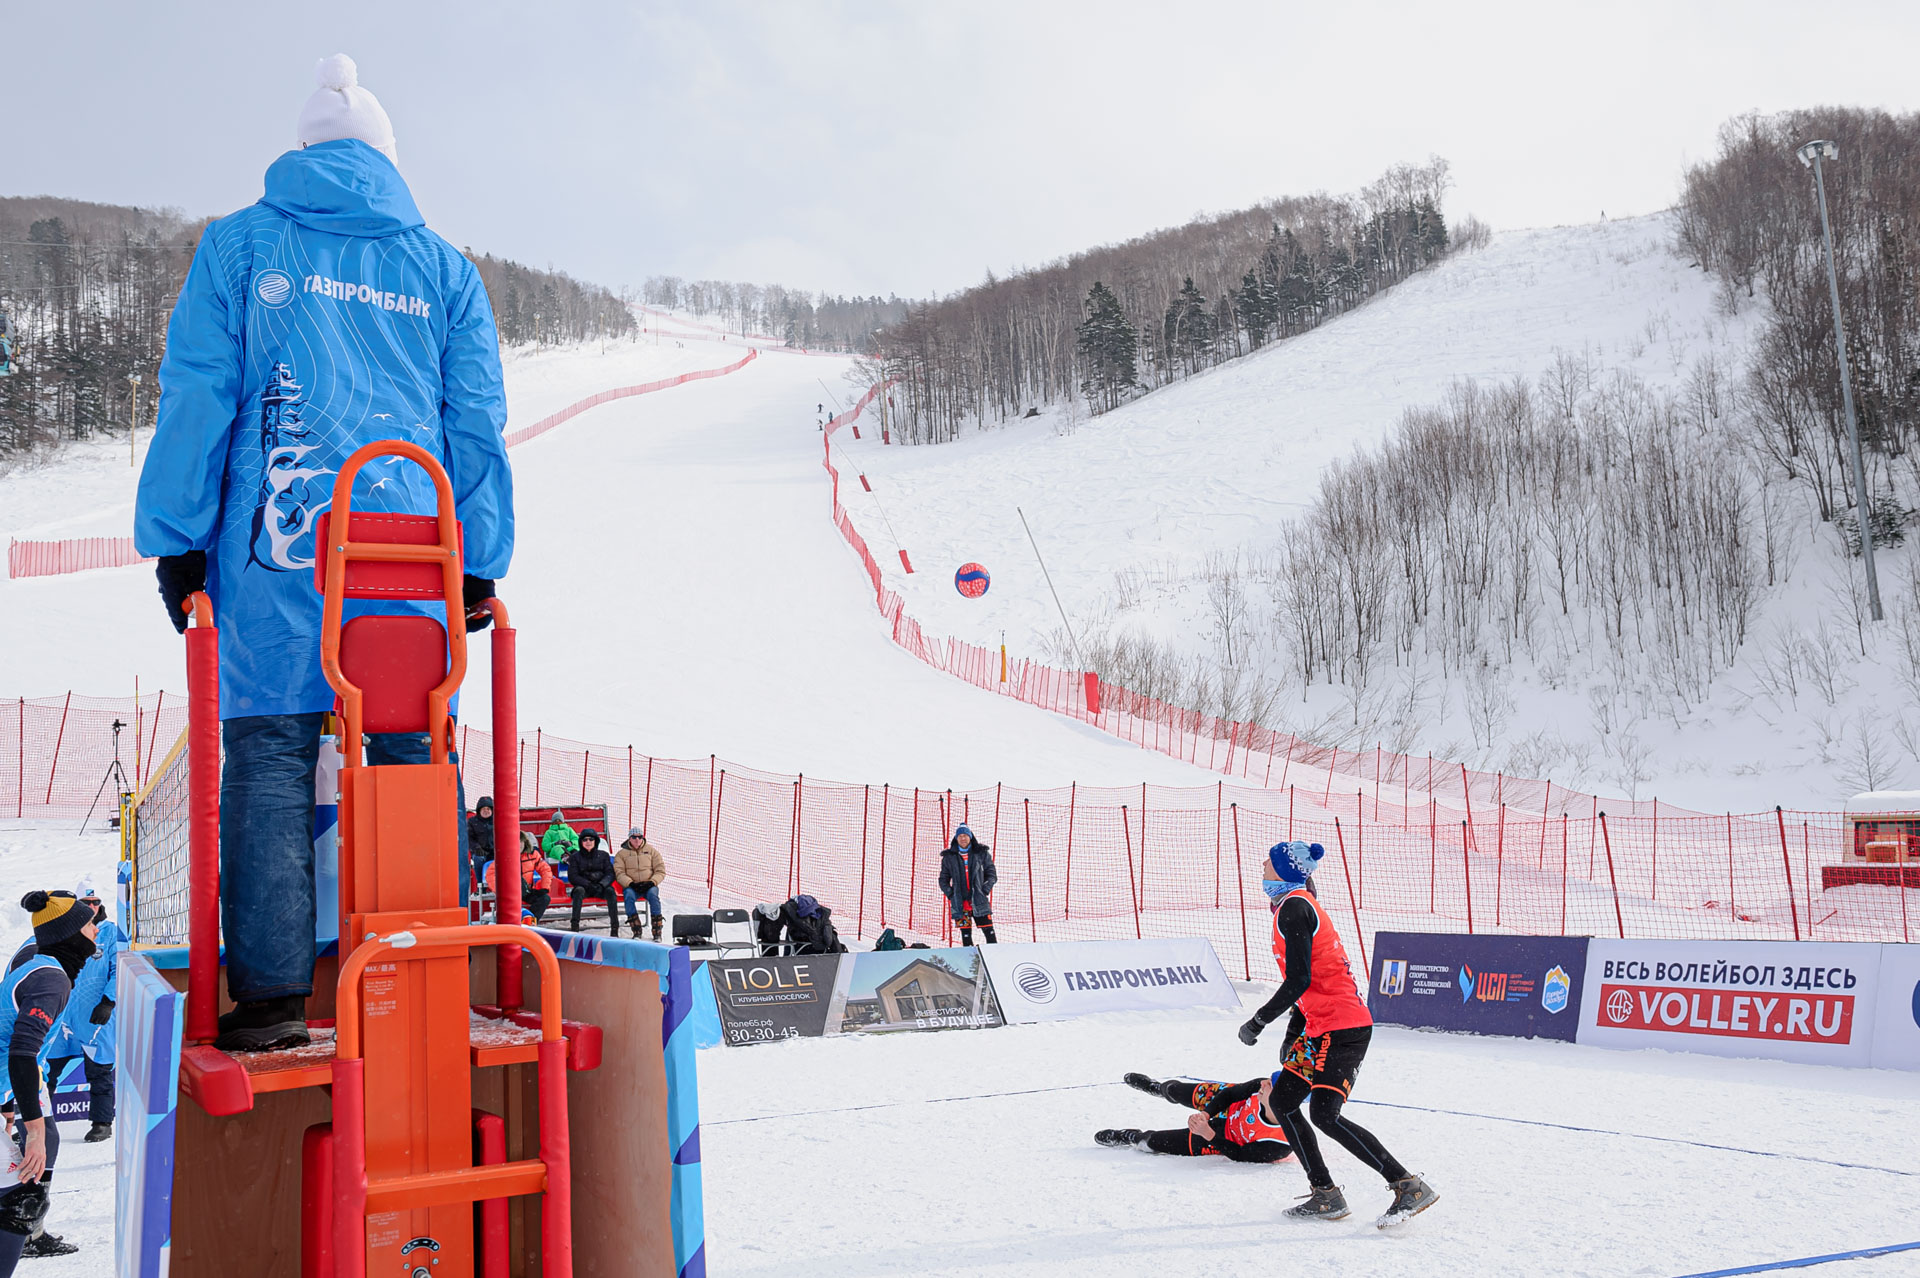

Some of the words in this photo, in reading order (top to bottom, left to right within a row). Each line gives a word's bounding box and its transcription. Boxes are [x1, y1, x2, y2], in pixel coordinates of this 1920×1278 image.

[303, 274, 432, 319] ГАЗПРОМБАНК
[1064, 965, 1208, 991] ГАЗПРОМБАНК
[1410, 964, 1449, 972] МИНИСТЕРСТВО
[1604, 961, 1650, 981] ВЕСЬ
[1655, 960, 1776, 986] ВОЛЕЙБОЛ
[1781, 966, 1857, 990] ЗДЕСЬ
[1414, 980, 1452, 988] САХАЛИНСКОЙ
[1476, 972, 1508, 1002] ЦСП
[914, 1006, 967, 1017] ИНВЕСТИРУЙ
[916, 1019, 926, 1028] В
[930, 1014, 995, 1027] БУДУЩЕЕ
[1639, 990, 1843, 1037] VOLLEY.RU
[730, 1026, 799, 1042] 30-30-45
